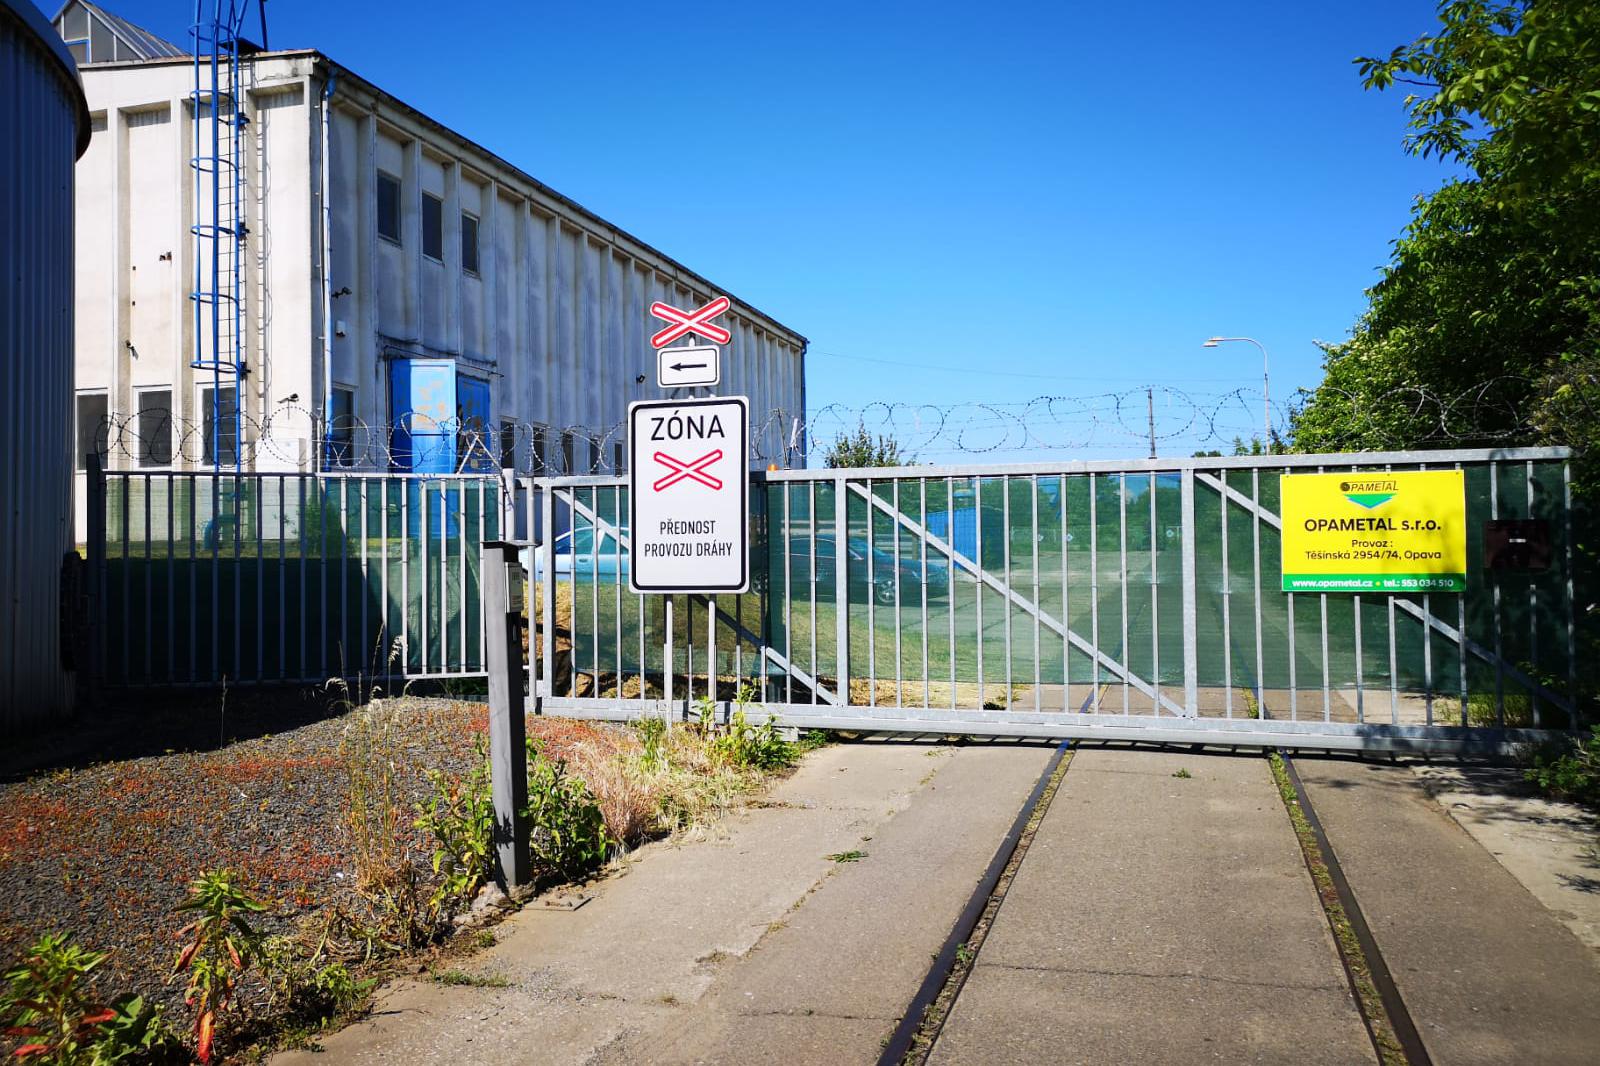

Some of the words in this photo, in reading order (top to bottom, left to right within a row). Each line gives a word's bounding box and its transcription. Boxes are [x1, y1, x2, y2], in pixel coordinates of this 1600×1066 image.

[650, 410, 725, 441] ZÓNA
[660, 518, 716, 535] PŘEDNOST
[1304, 517, 1397, 532] OPAMETAL
[1401, 519, 1441, 531] s.r.o.
[644, 543, 692, 557] PROVOZU
[696, 540, 733, 556] DRÁHY
[1352, 550, 1402, 561] 2954/74,
[1404, 550, 1442, 561] Opava
[1401, 579, 1418, 588] 553
[1419, 579, 1437, 588] 034
[1439, 579, 1454, 587] 510
